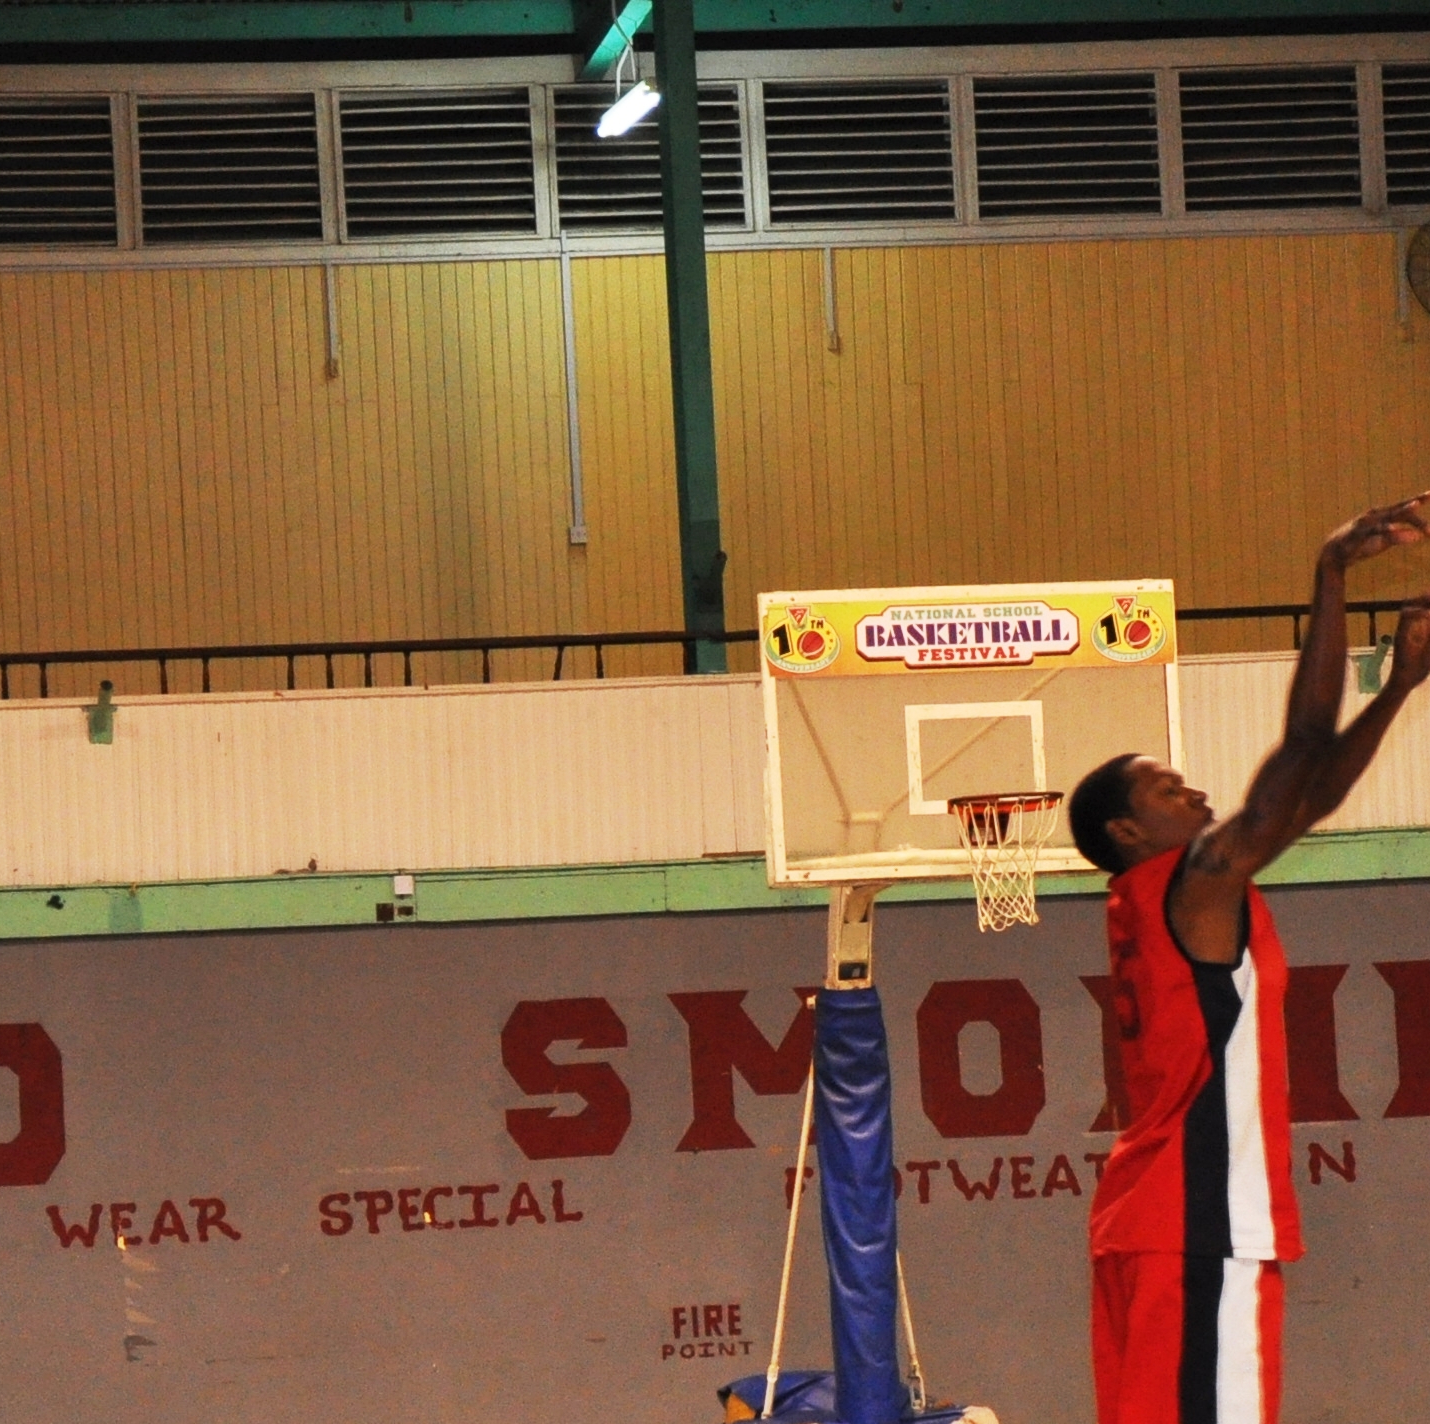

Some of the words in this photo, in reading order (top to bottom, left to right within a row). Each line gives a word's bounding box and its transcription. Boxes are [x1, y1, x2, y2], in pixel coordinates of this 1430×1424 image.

[891, 607, 976, 621] NATIONAL
[983, 604, 1042, 617] SCHOOL
[865, 618, 1070, 648] BASKETBALL
[917, 645, 1020, 662] FESTIVAL
[46, 1196, 242, 1252] WEAR
[317, 1179, 584, 1238] SPECIAL
[671, 1303, 743, 1342] FIRE
[660, 1339, 754, 1362] POINT
